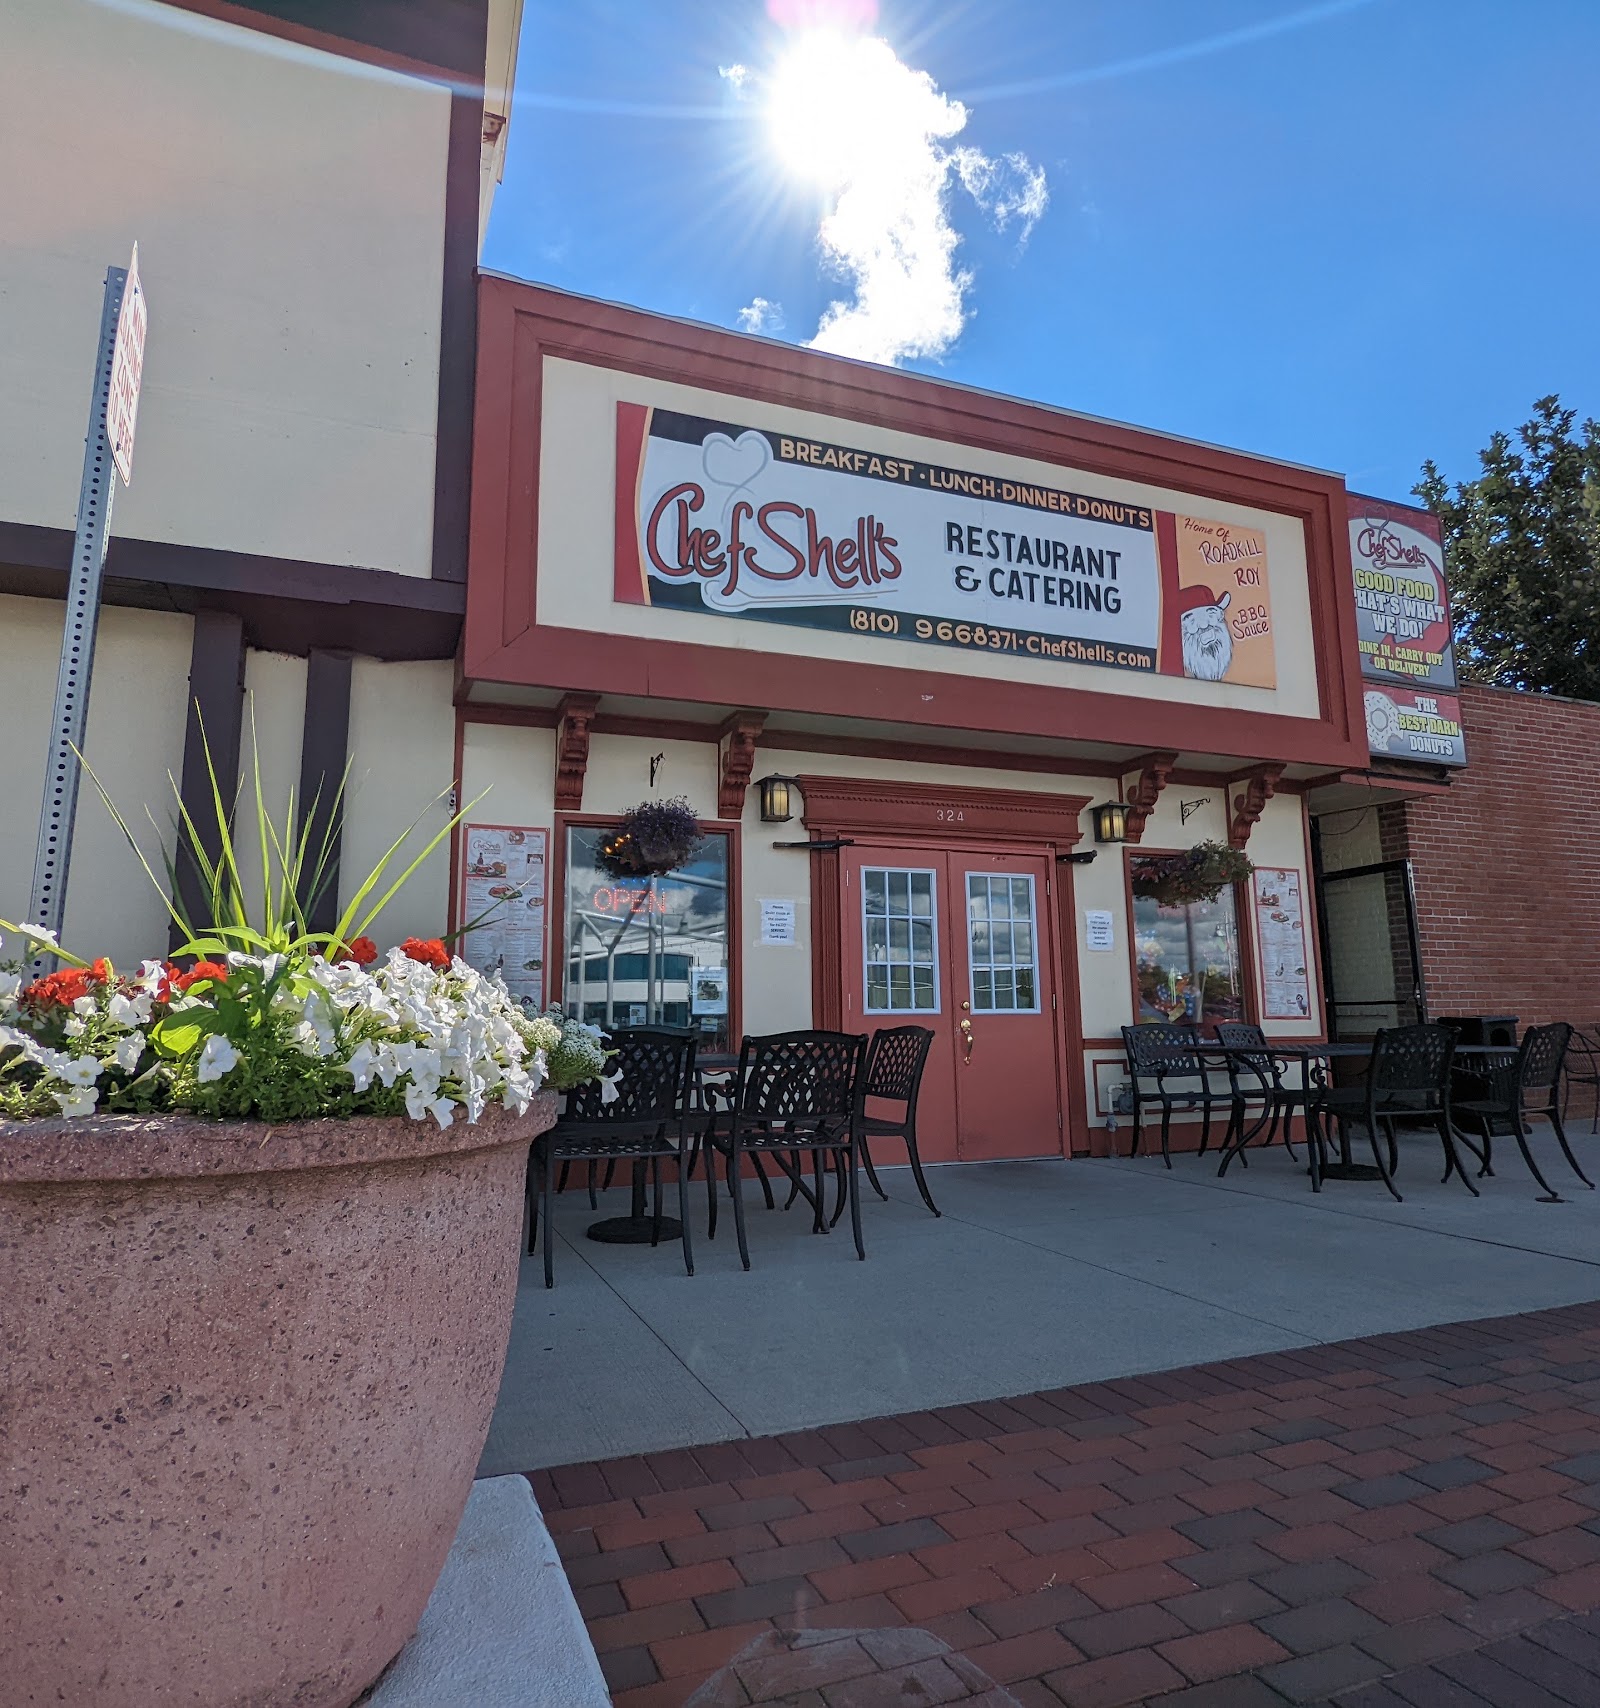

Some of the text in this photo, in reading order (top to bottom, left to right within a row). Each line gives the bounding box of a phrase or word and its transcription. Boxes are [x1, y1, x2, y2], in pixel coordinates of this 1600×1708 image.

[780, 439, 914, 482] BREAKFAST
[1184, 517, 1214, 535] Home
[946, 522, 1122, 580] RESTAURANT
[1233, 567, 1261, 587] ROY
[1355, 568, 1435, 601] GOOD FOOD
[954, 565, 1122, 615] & CATERING
[849, 609, 899, 634] (810)
[1238, 604, 1268, 624] BBQ
[1402, 598, 1445, 622] WHAT
[1232, 619, 1269, 640] Sauce
[1372, 613, 1425, 640] WE DO!
[1357, 640, 1380, 656] DINE
[1395, 647, 1425, 663] CARRY
[1426, 653, 1443, 667] OUT
[1374, 656, 1430, 677] OR DELIVERY
[1415, 696, 1438, 715] THE
[1398, 713, 1460, 737] BEST DARN
[1409, 735, 1454, 756] DONUTS
[937, 809, 964, 821] 324
[593, 887, 667, 913] OPEN
